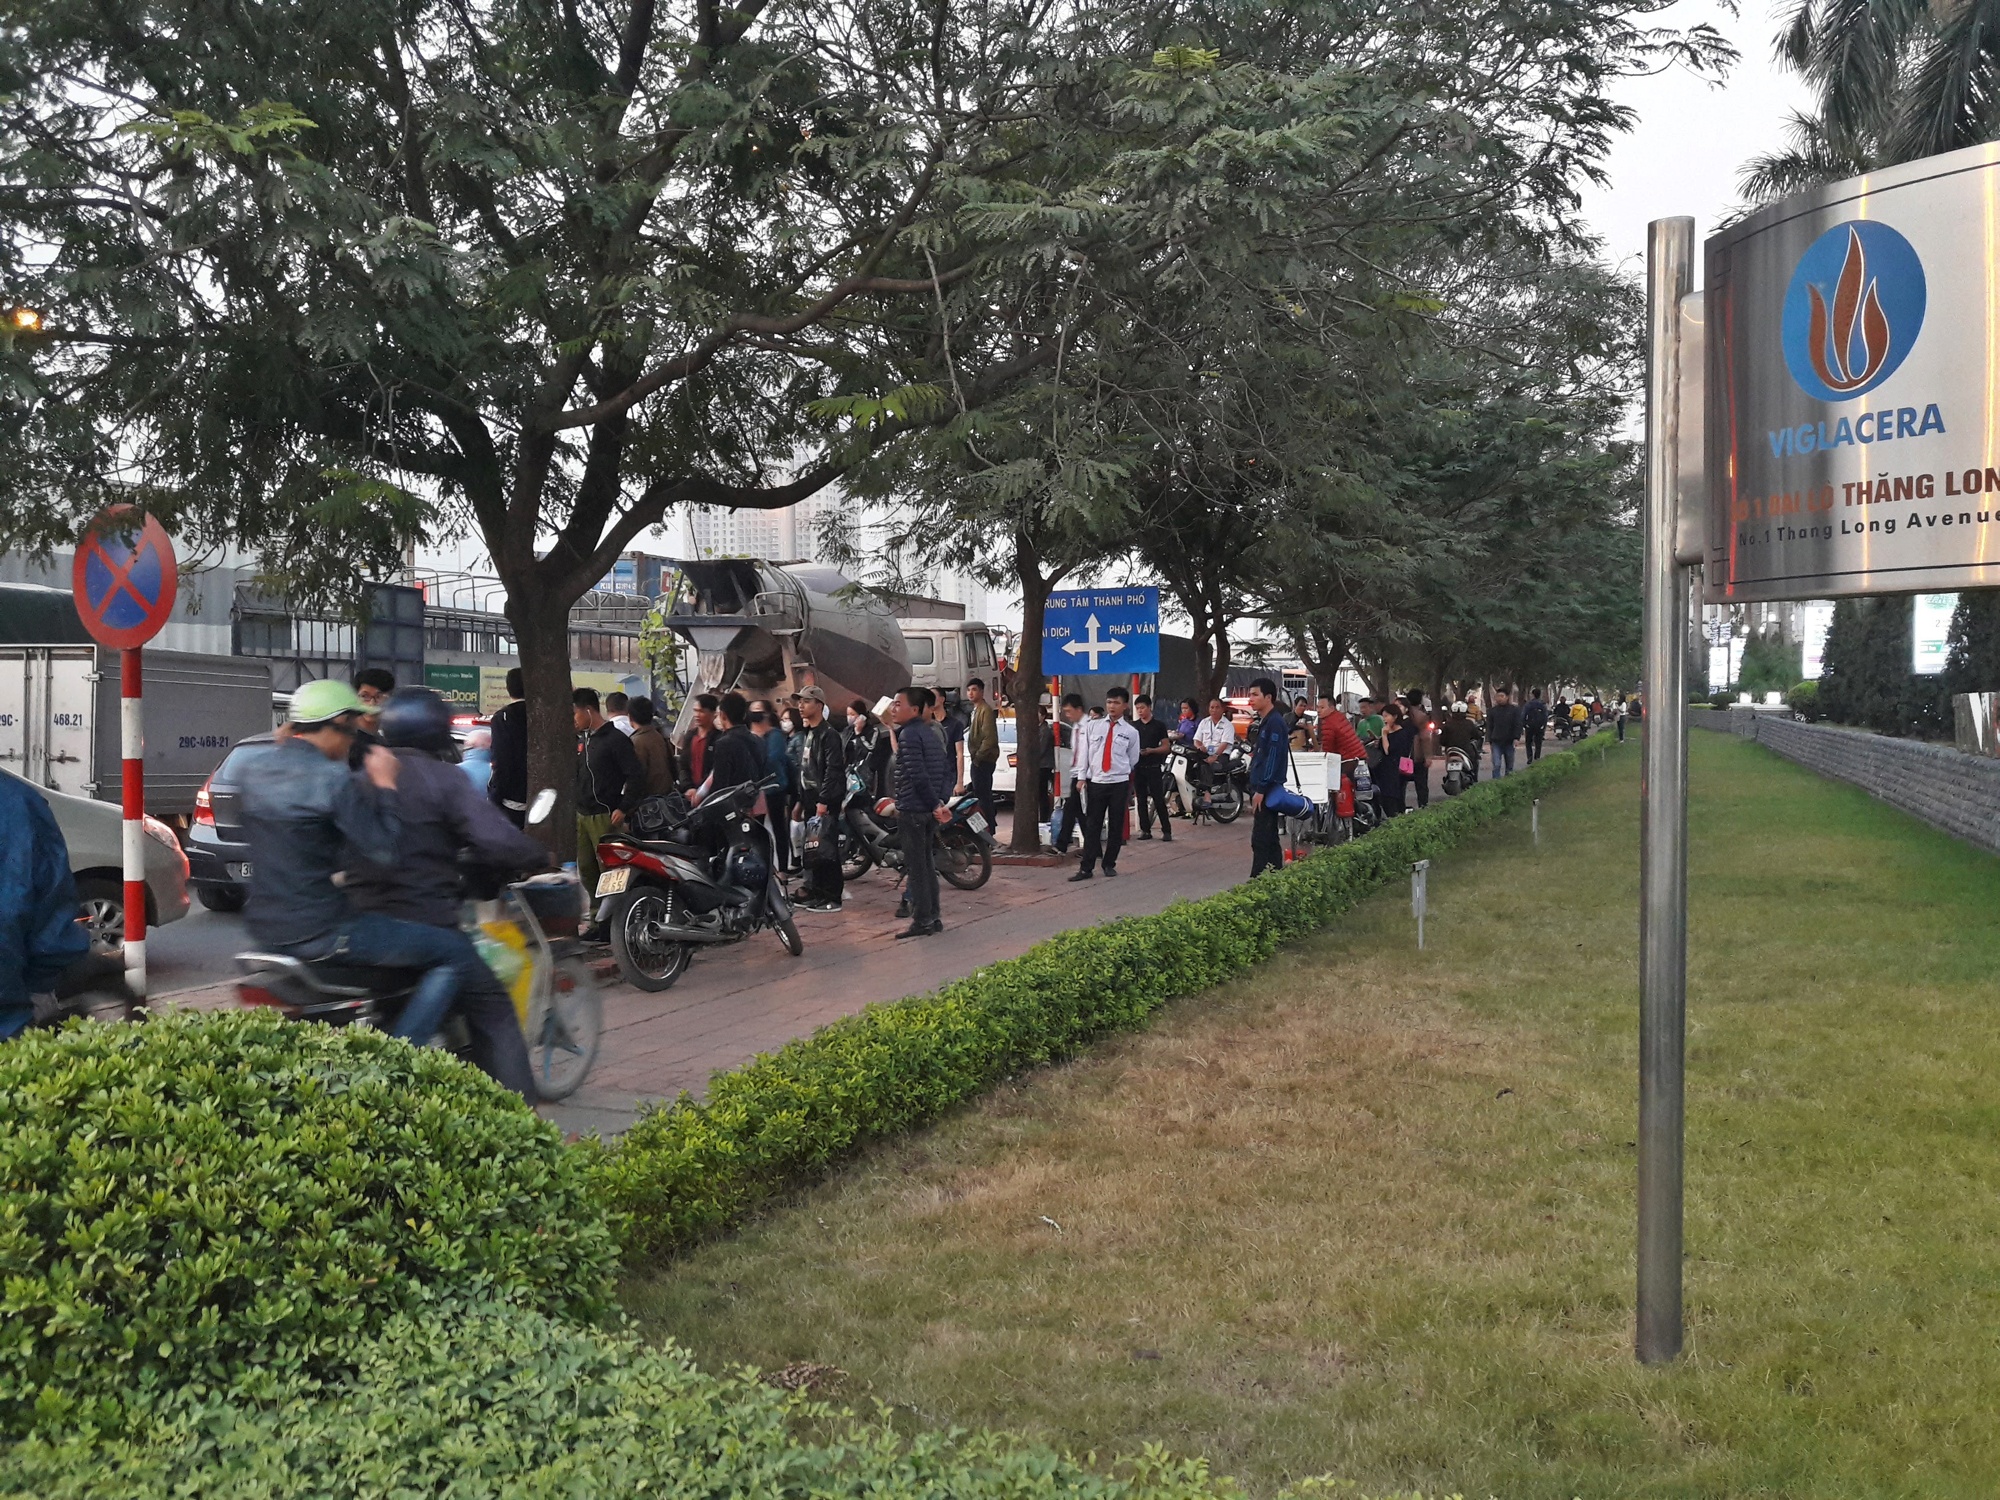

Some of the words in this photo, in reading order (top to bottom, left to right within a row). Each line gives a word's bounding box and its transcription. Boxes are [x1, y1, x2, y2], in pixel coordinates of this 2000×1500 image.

[1768, 403, 1946, 458] VIGLACERA
[1842, 472, 1934, 506] THĂNG
[1777, 525, 1833, 541] Thang
[1841, 518, 1896, 535] Long
[1044, 598, 1067, 608] RUNG
[1071, 594, 1089, 607] TÂM
[1094, 593, 1123, 606] THÀNH
[1127, 591, 1145, 605] PHỐ
[1050, 626, 1070, 640] DỊCH
[1109, 622, 1132, 635] PHÁP
[1136, 621, 1156, 634] VÂN
[53, 713, 83, 726] 468.21
[178, 736, 229, 748] 29C-468-21
